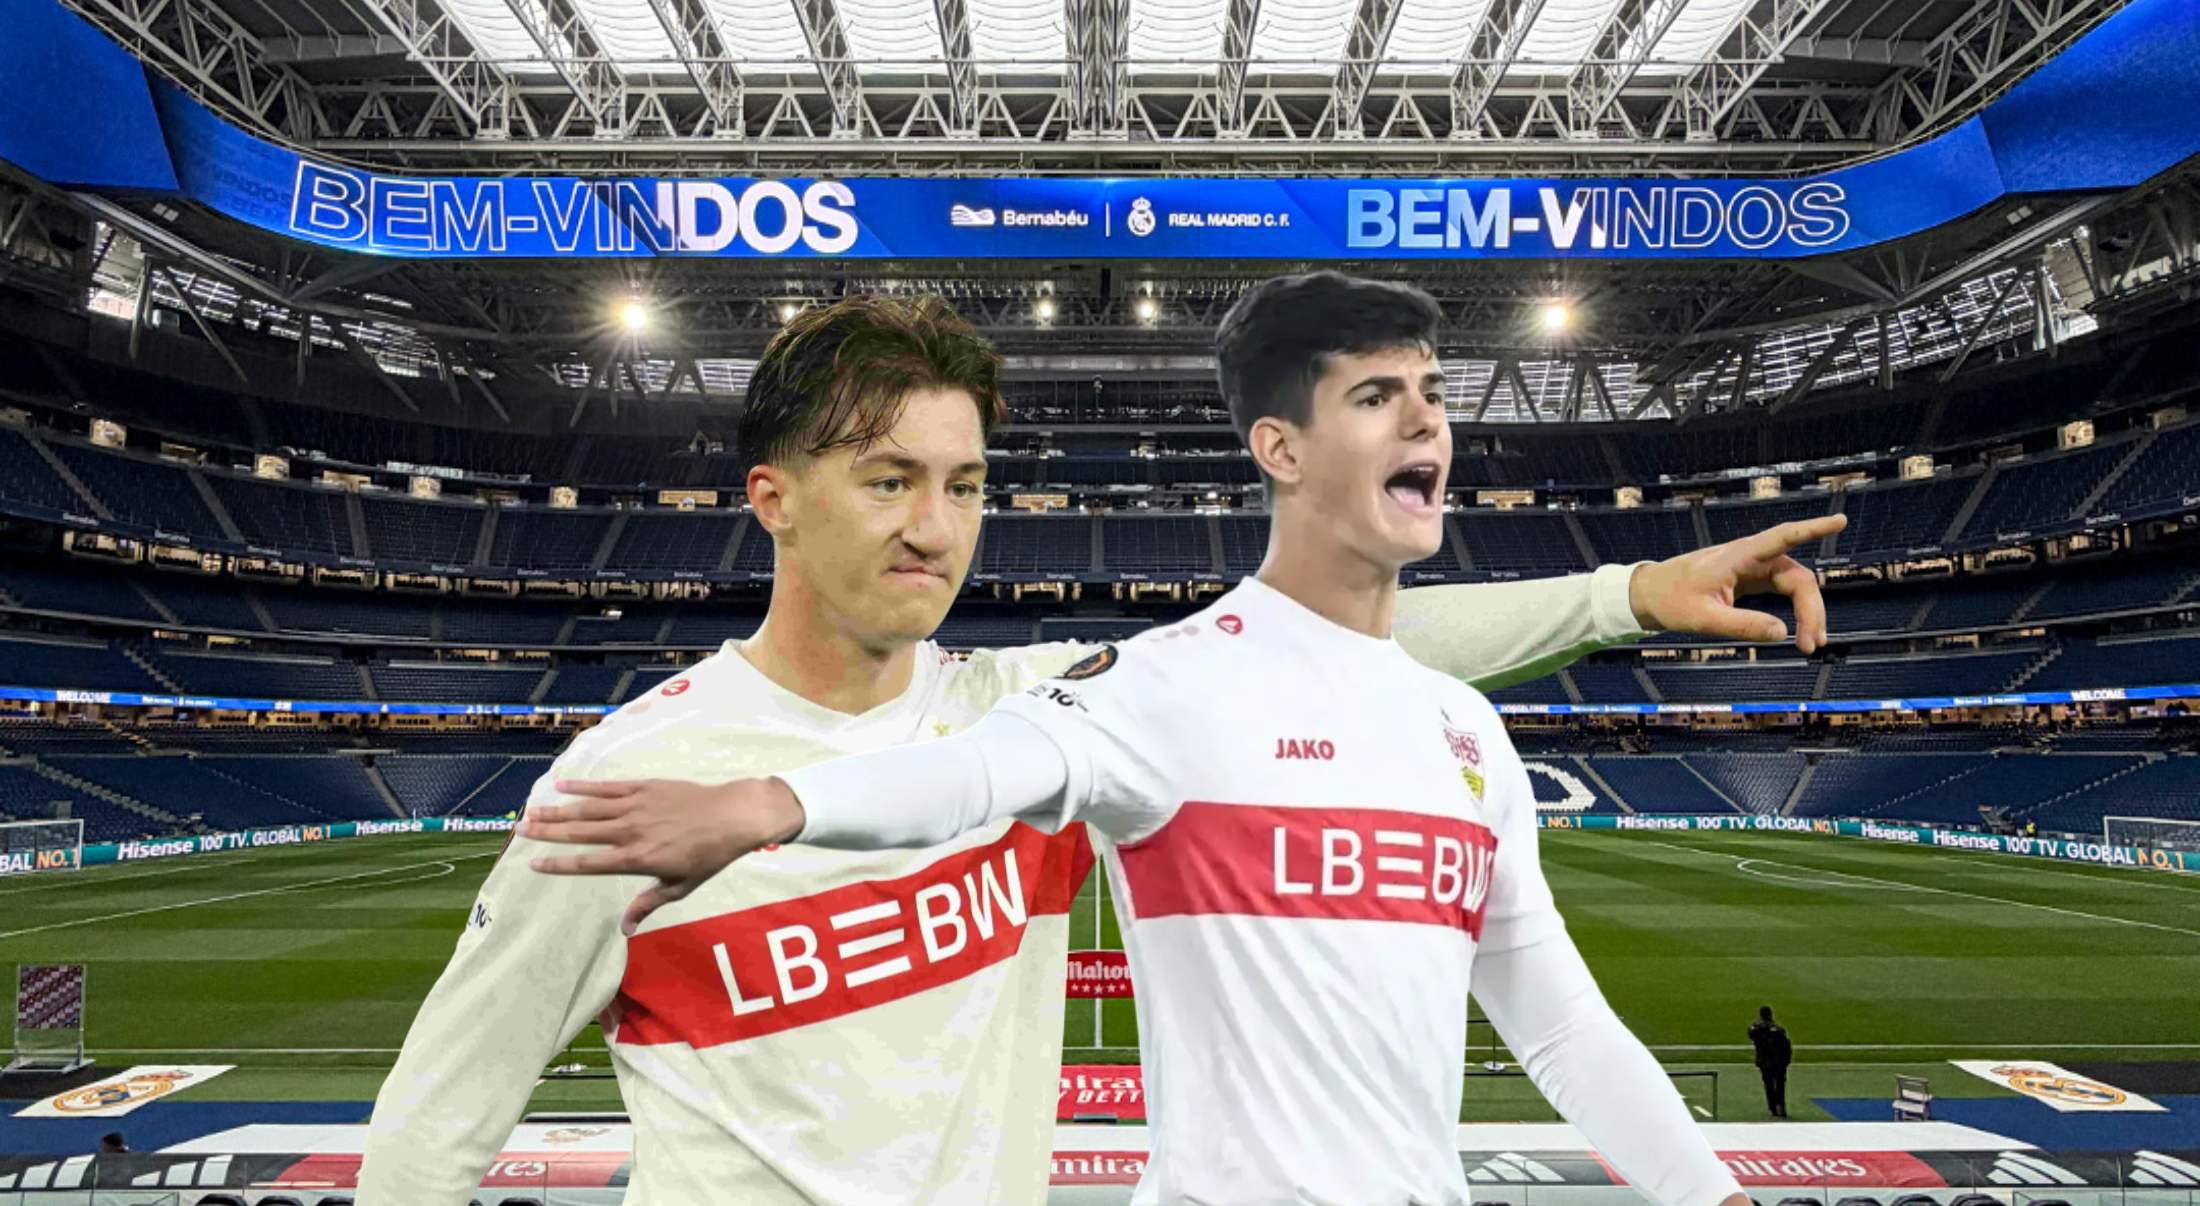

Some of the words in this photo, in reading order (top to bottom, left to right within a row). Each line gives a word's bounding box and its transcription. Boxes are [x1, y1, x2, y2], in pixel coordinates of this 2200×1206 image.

[289, 160, 858, 251] BEM-VINDOS
[1346, 182, 1850, 249] BEM-VINDOS
[1003, 209, 1089, 227] Bernabéu
[1168, 212, 1205, 227] REAL
[1207, 212, 1261, 227] MADRID
[1274, 738, 1336, 760] JAKO
[356, 819, 423, 836] Hisense
[1616, 814, 1689, 830] Hisense
[1728, 815, 1751, 830] TV.
[1754, 815, 1812, 832] GLOBAL
[1861, 823, 1919, 843] Hisense
[117, 839, 194, 860] Hisense
[229, 829, 249, 848] TV.
[252, 828, 300, 846] GLOBAL
[1932, 829, 2000, 851] Hisense
[2037, 838, 2063, 857] TV.
[2066, 842, 2136, 865] GLOBAL
[0, 853, 33, 873] BAL
[1077, 1090, 1143, 1103] BETT
